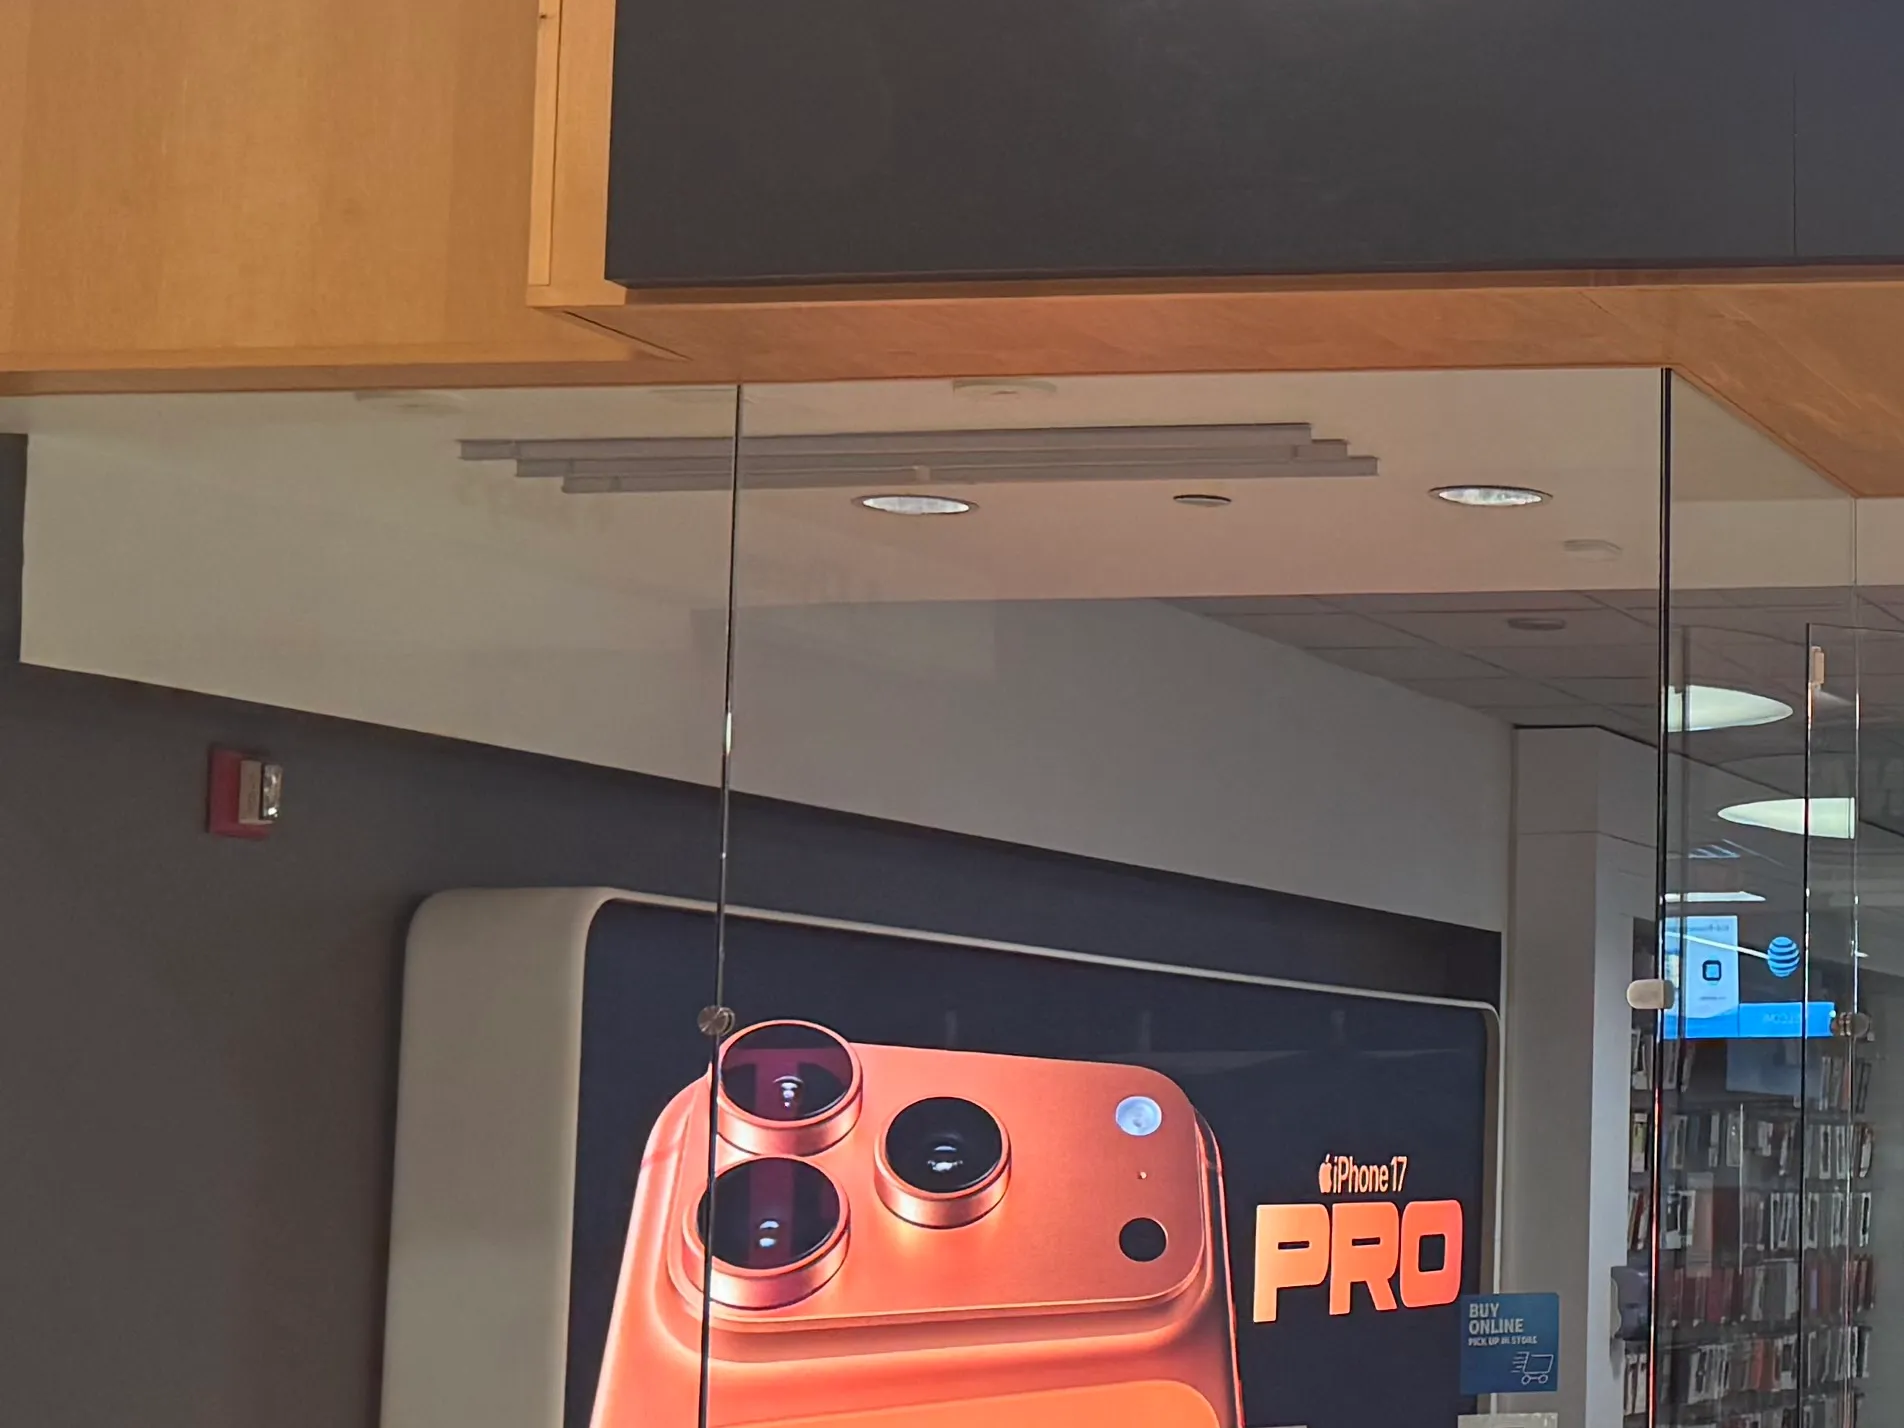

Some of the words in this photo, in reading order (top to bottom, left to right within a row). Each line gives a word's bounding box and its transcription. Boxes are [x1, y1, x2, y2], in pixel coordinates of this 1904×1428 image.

[1333, 1156, 1389, 1193] iPhone
[1390, 1156, 1408, 1192] 17
[1253, 1199, 1463, 1323] PRO
[1469, 1303, 1499, 1318] BUY
[1468, 1318, 1524, 1335] ONLINE
